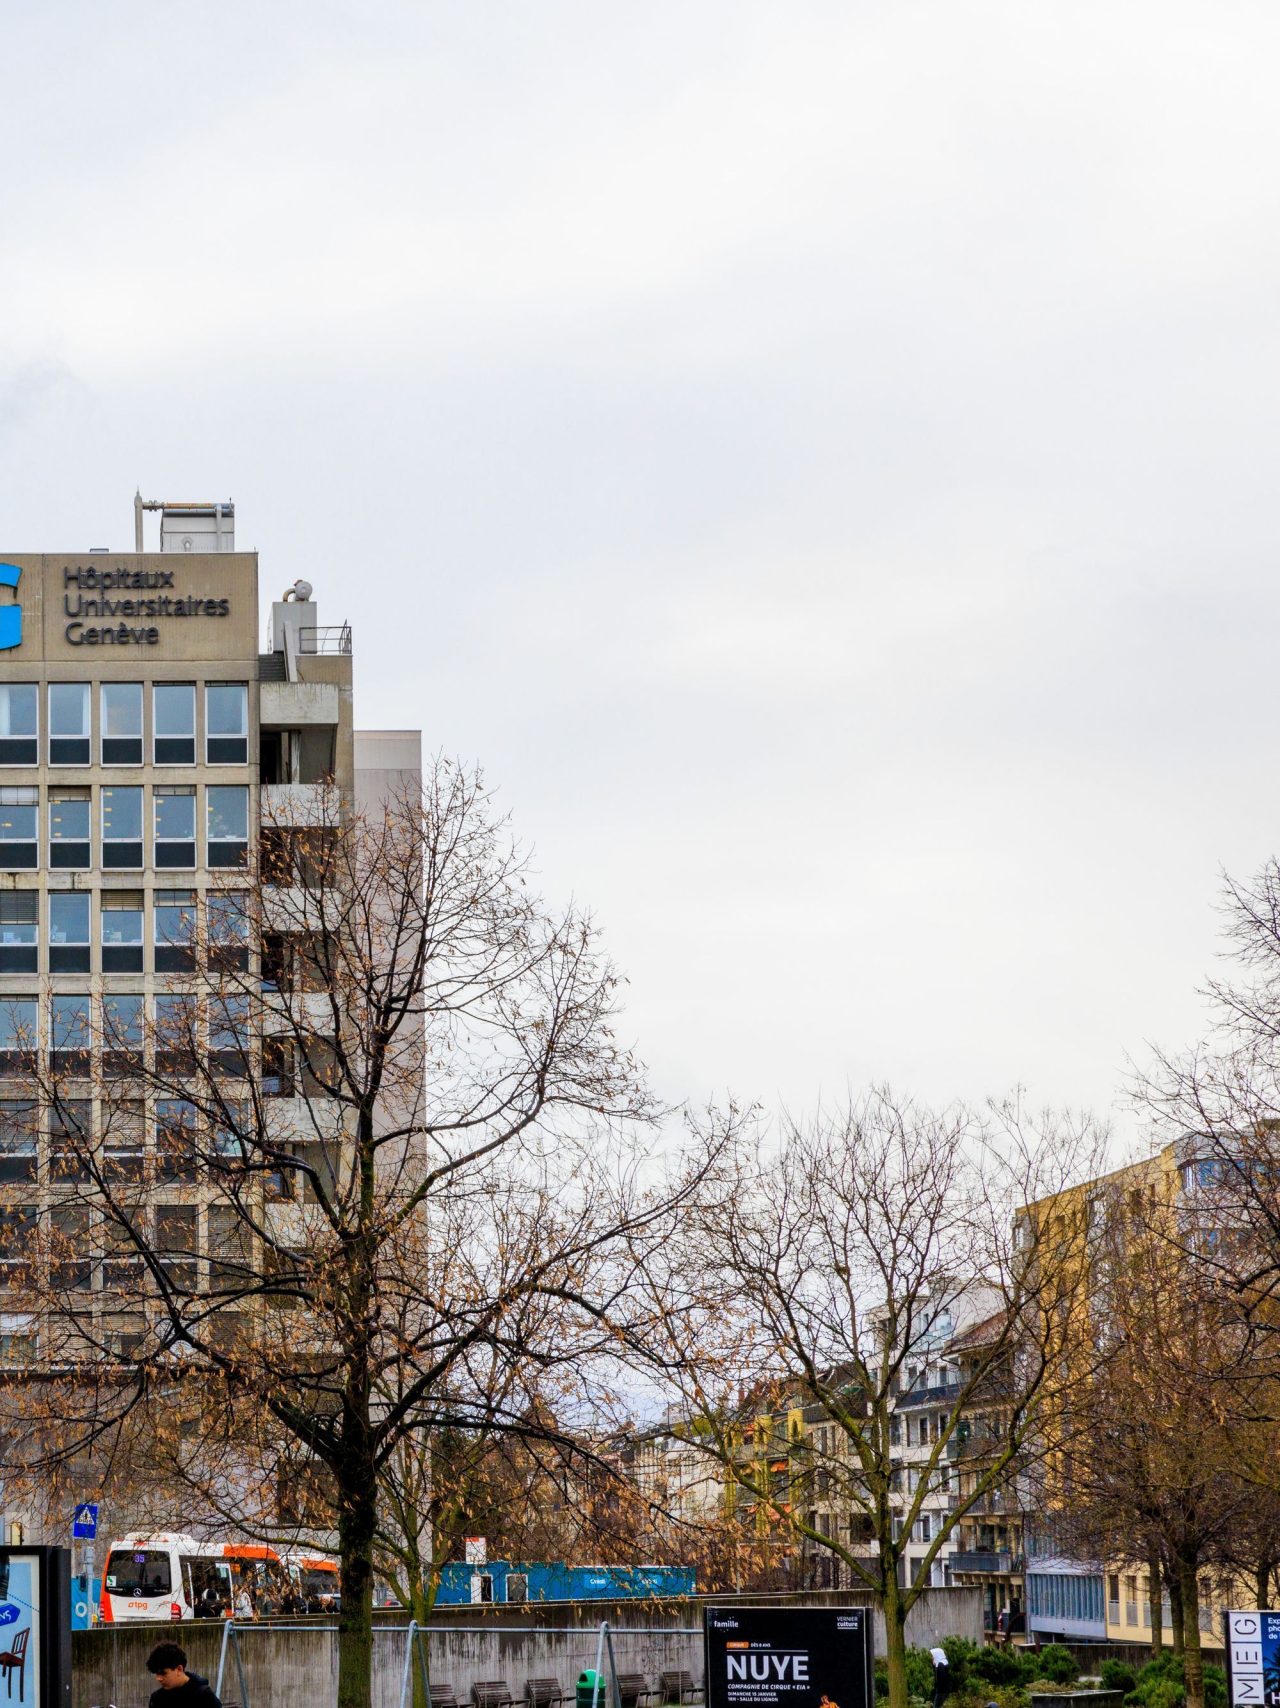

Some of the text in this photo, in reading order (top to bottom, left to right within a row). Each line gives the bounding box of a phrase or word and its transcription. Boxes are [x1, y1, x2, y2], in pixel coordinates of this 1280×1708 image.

[64, 566, 175, 597] Hôpitaux
[64, 594, 229, 617] Universitaires
[65, 620, 160, 646] Genève
[134, 1554, 145, 1563] 35
[135, 1601, 148, 1610] tpg
[714, 1620, 739, 1628] famille
[727, 1655, 809, 1681] NUYE
[1234, 1619, 1260, 1698] MEG
